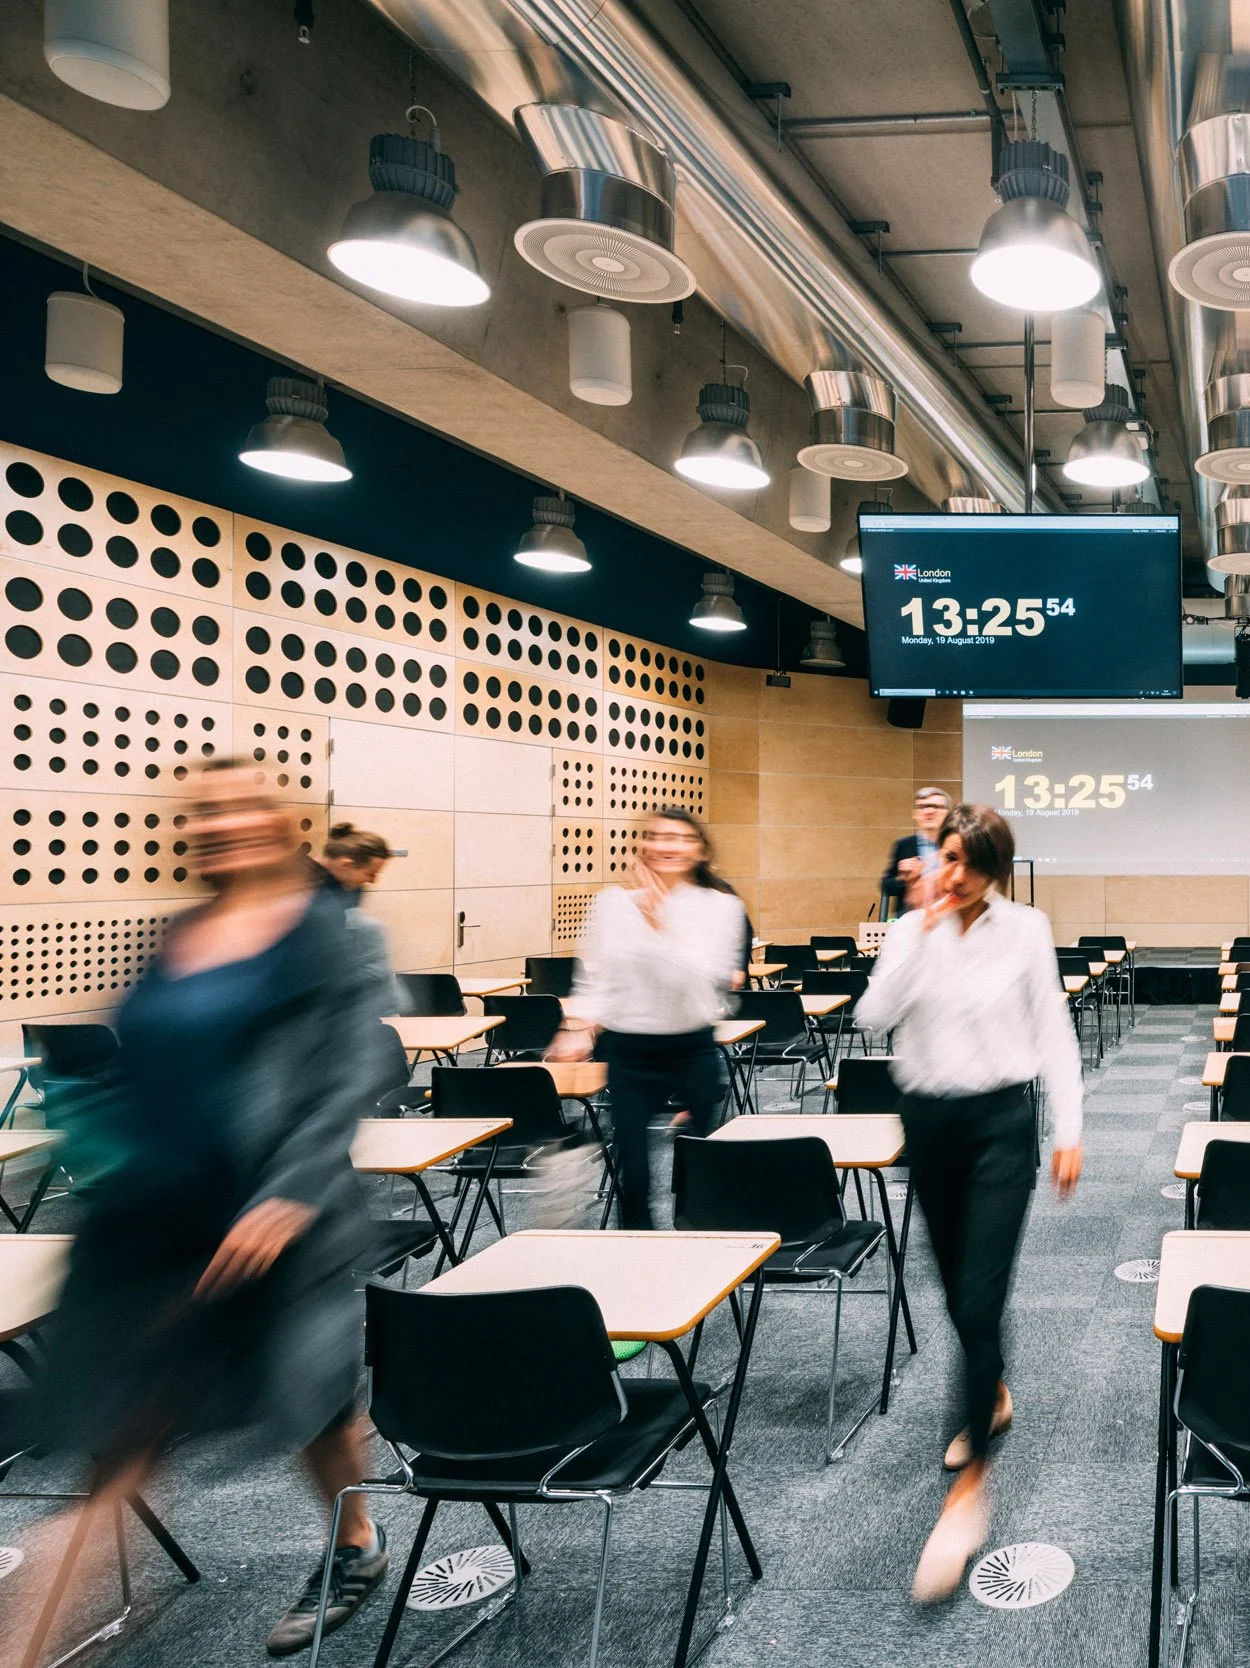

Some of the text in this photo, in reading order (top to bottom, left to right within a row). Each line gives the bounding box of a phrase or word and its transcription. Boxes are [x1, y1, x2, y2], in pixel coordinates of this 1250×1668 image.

[917, 568, 951, 578] London
[901, 597, 1076, 637] 13:25 54
[901, 636, 995, 645] Monday, 19 August 2019
[1012, 749, 1042, 757] London
[995, 774, 1154, 809] 13:25 54
[1035, 809, 1061, 817] August
